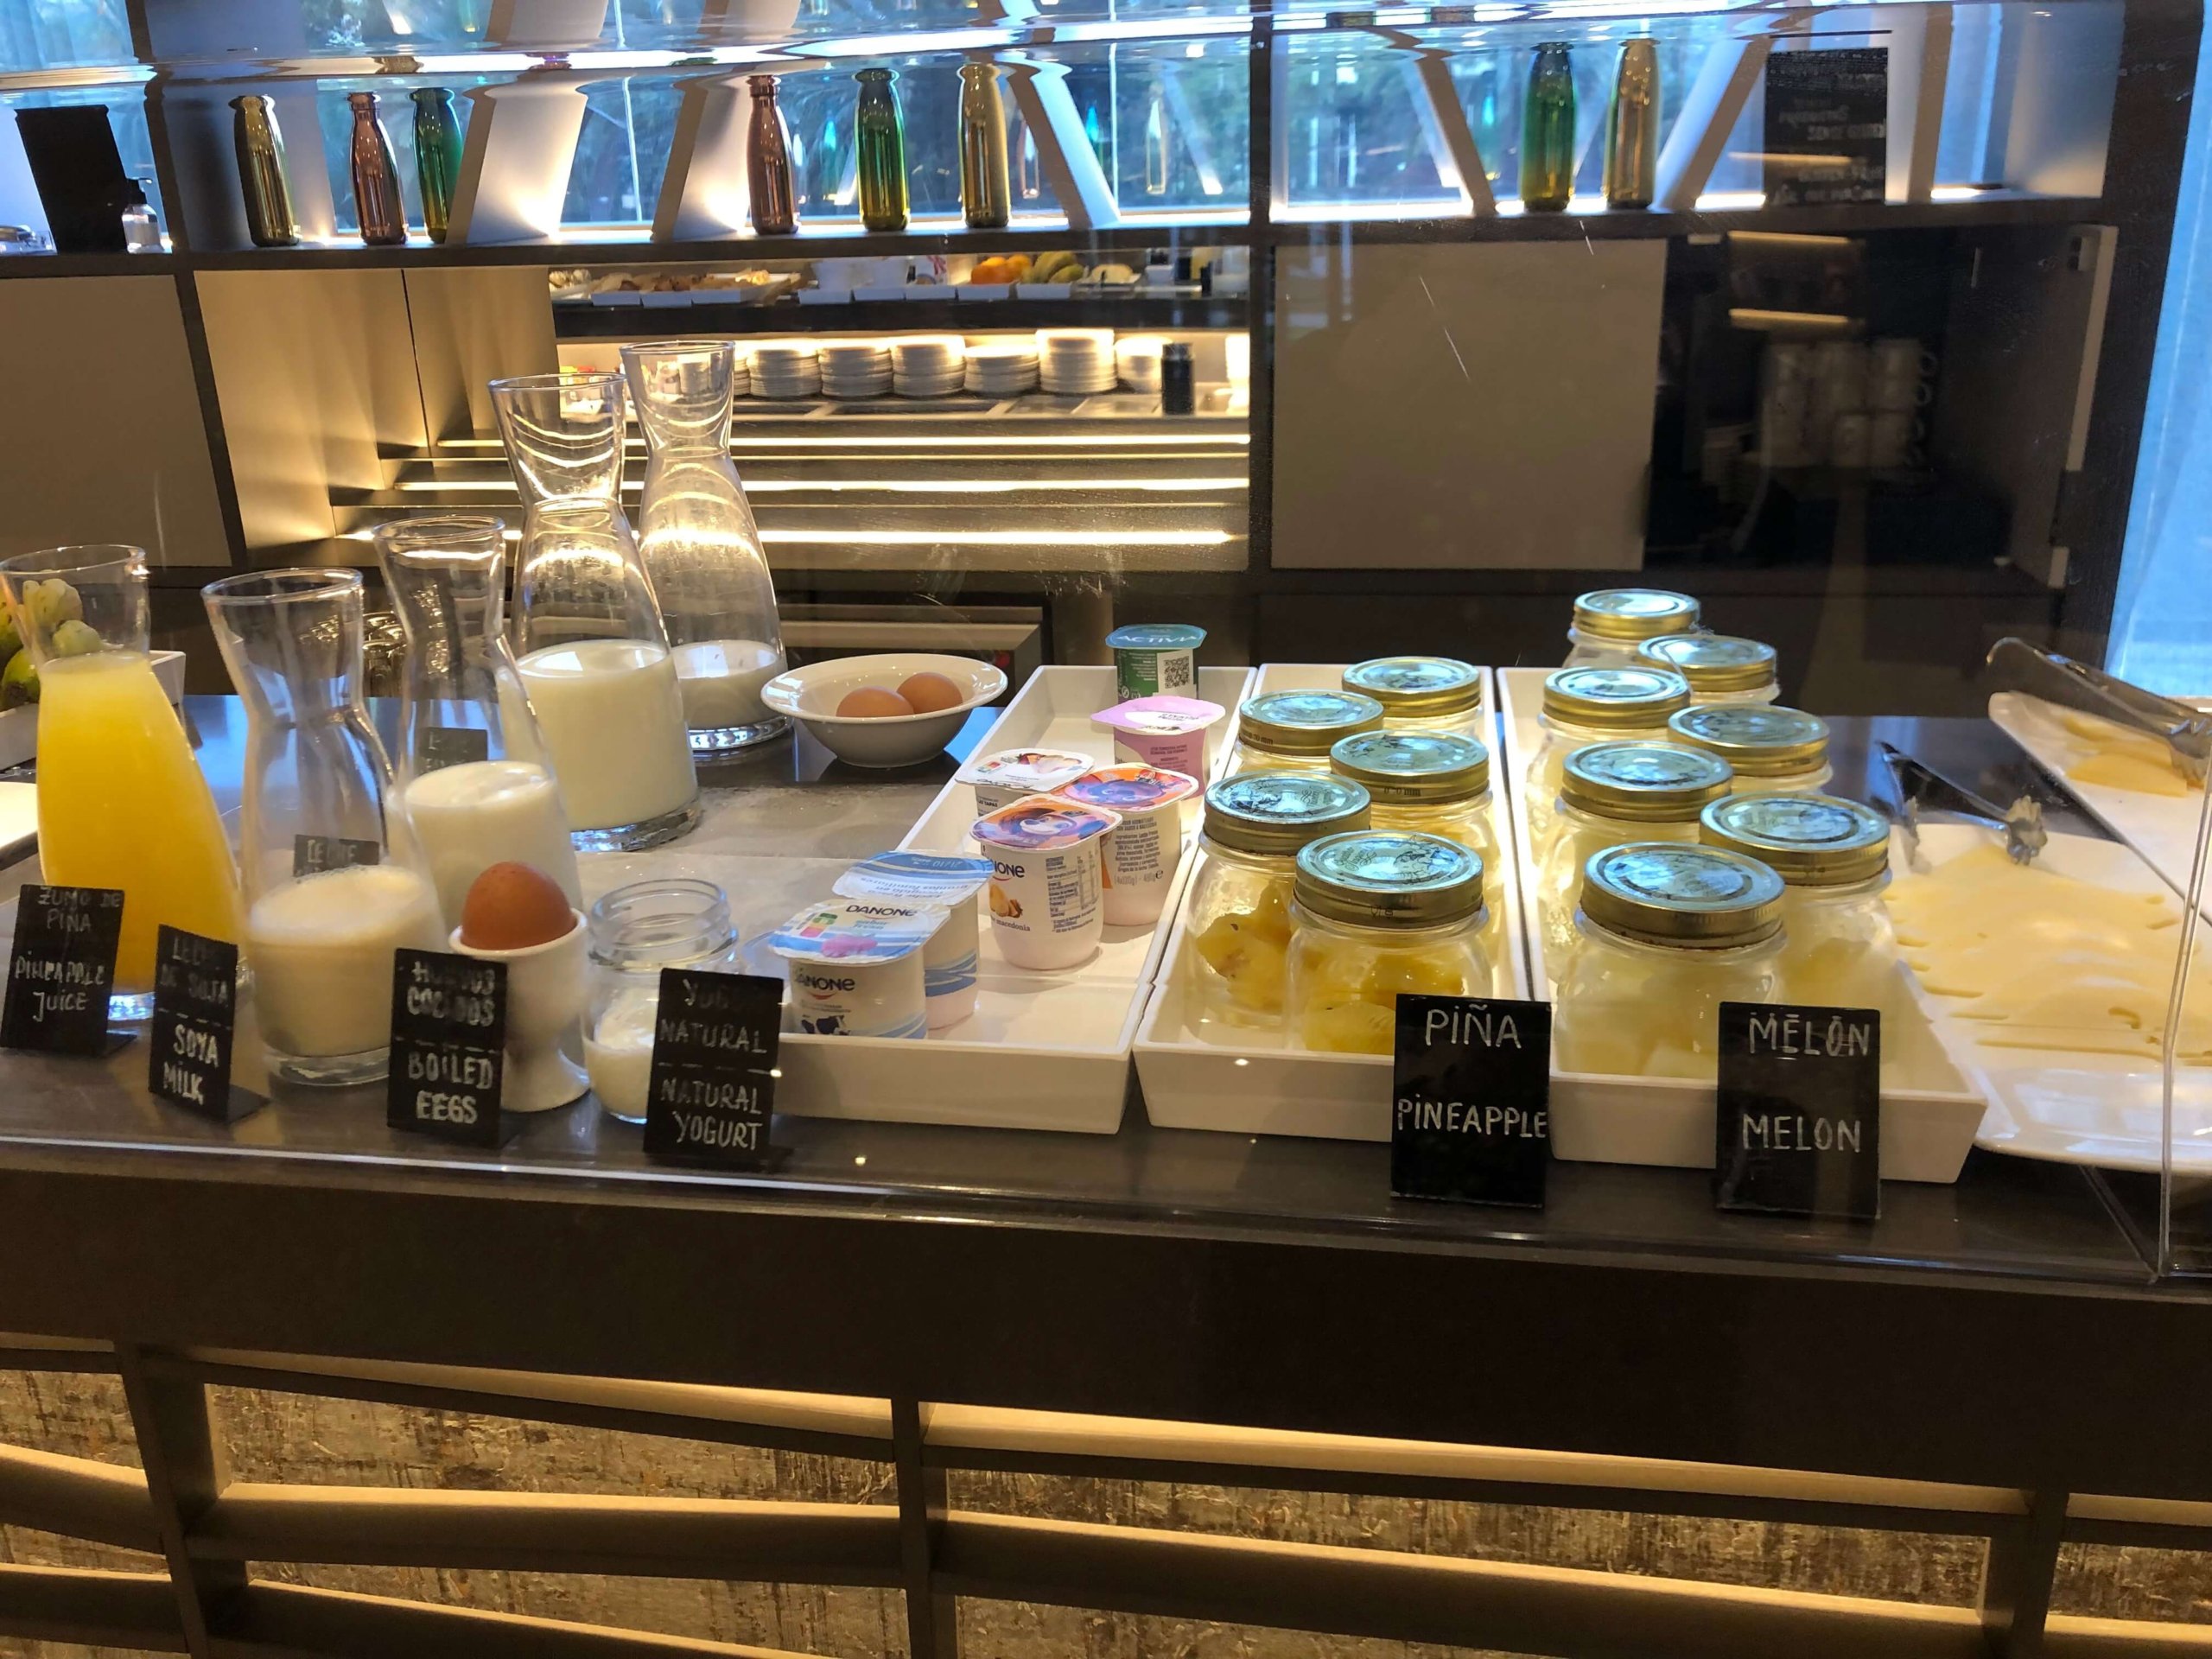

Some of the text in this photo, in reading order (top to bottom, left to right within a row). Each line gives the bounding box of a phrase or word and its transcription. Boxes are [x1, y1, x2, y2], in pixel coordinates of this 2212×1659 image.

[1116, 634, 1197, 644] ACTIVIA
[100, 891, 123, 908] DE
[996, 918, 1031, 931] macedonia
[173, 1023, 219, 1068] SOYA
[659, 1017, 768, 1054] NATURAL
[407, 1052, 493, 1090] BOILED
[660, 1077, 763, 1116] NATURAL
[671, 1109, 764, 1152] YOGURT
[1742, 1114, 1863, 1154] MELON
